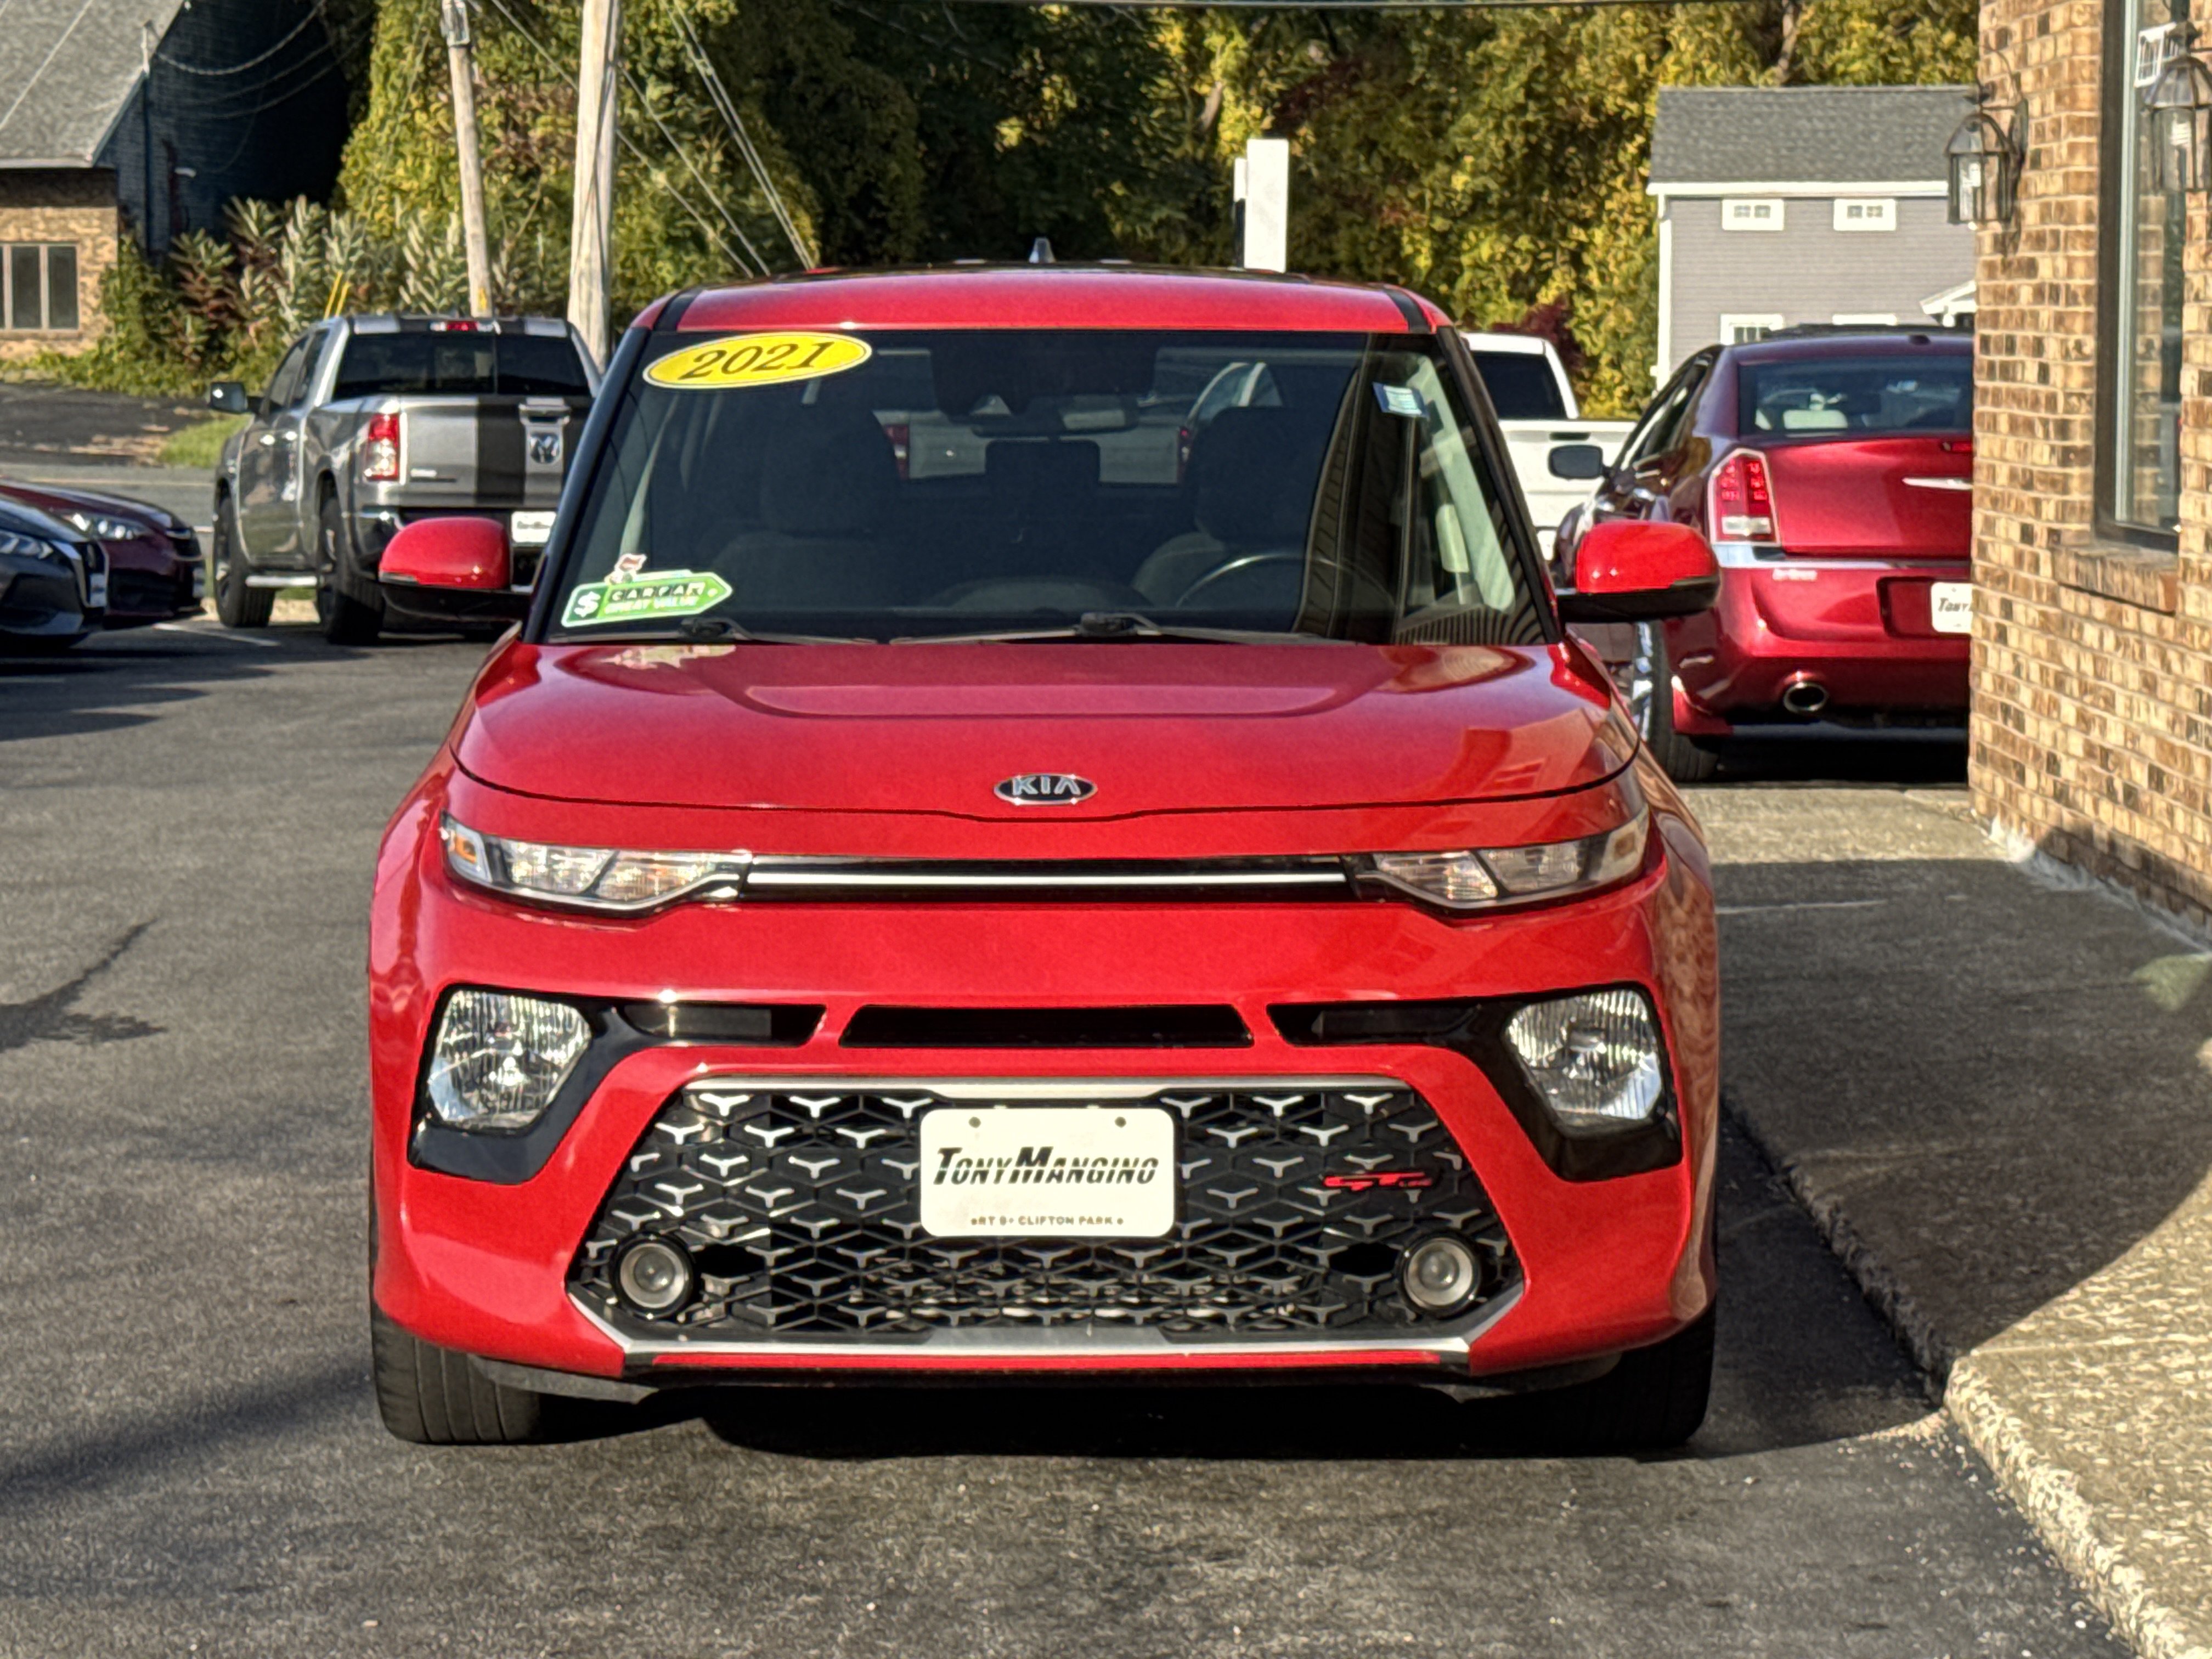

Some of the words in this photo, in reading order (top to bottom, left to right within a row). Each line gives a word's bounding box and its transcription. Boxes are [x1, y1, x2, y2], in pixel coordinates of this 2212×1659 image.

[677, 341, 836, 380] 2021
[1012, 776, 1081, 795] KIA
[1018, 1215, 1074, 1226] CLIFTON
[1078, 1215, 1113, 1226] PARK
